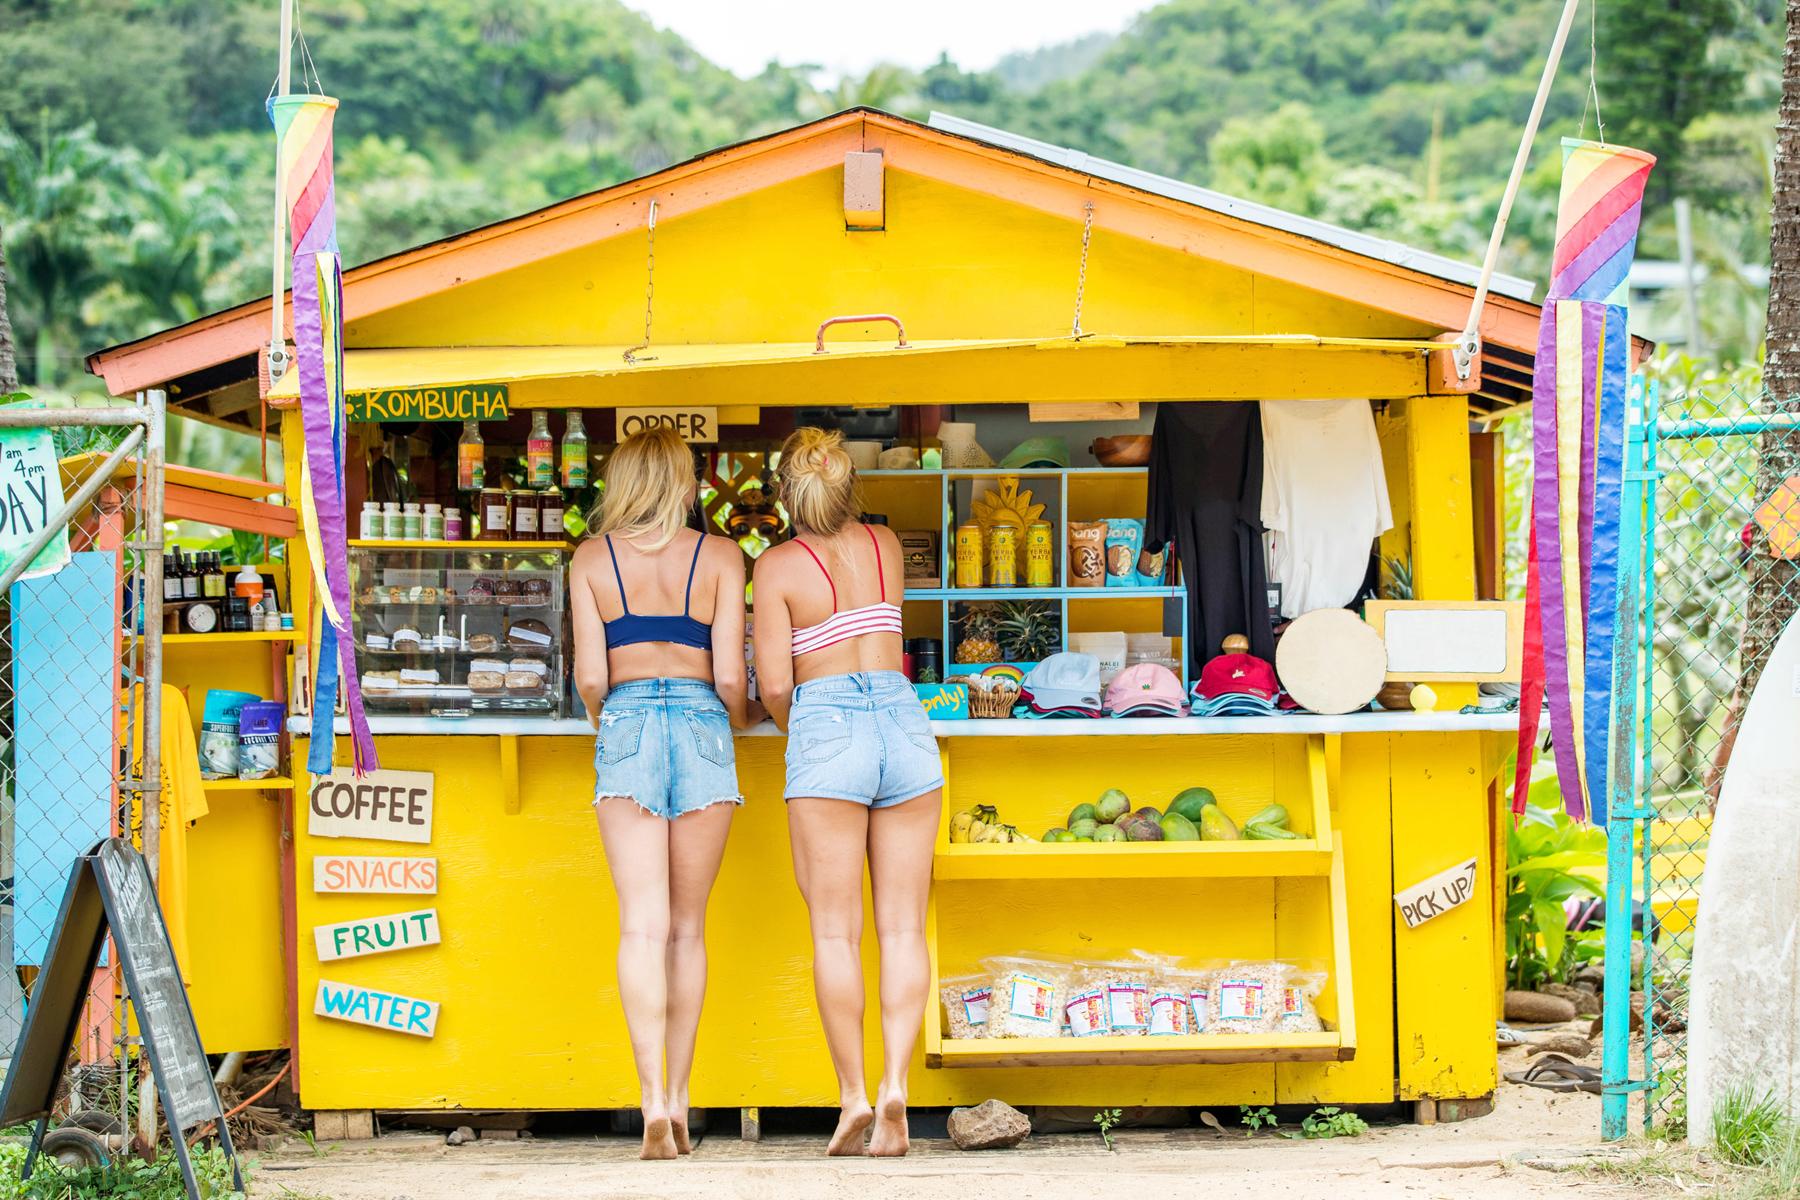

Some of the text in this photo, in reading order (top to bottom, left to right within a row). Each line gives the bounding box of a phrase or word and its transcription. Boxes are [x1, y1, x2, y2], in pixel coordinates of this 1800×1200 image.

[365, 389, 508, 420] KOMBUCHA
[921, 685, 965, 713] only!
[311, 780, 427, 826] COFFEE
[324, 859, 436, 890] SNACKS
[1402, 877, 1468, 927] PICK UP
[333, 913, 433, 956] FRUIT
[322, 986, 433, 1033] WATER
